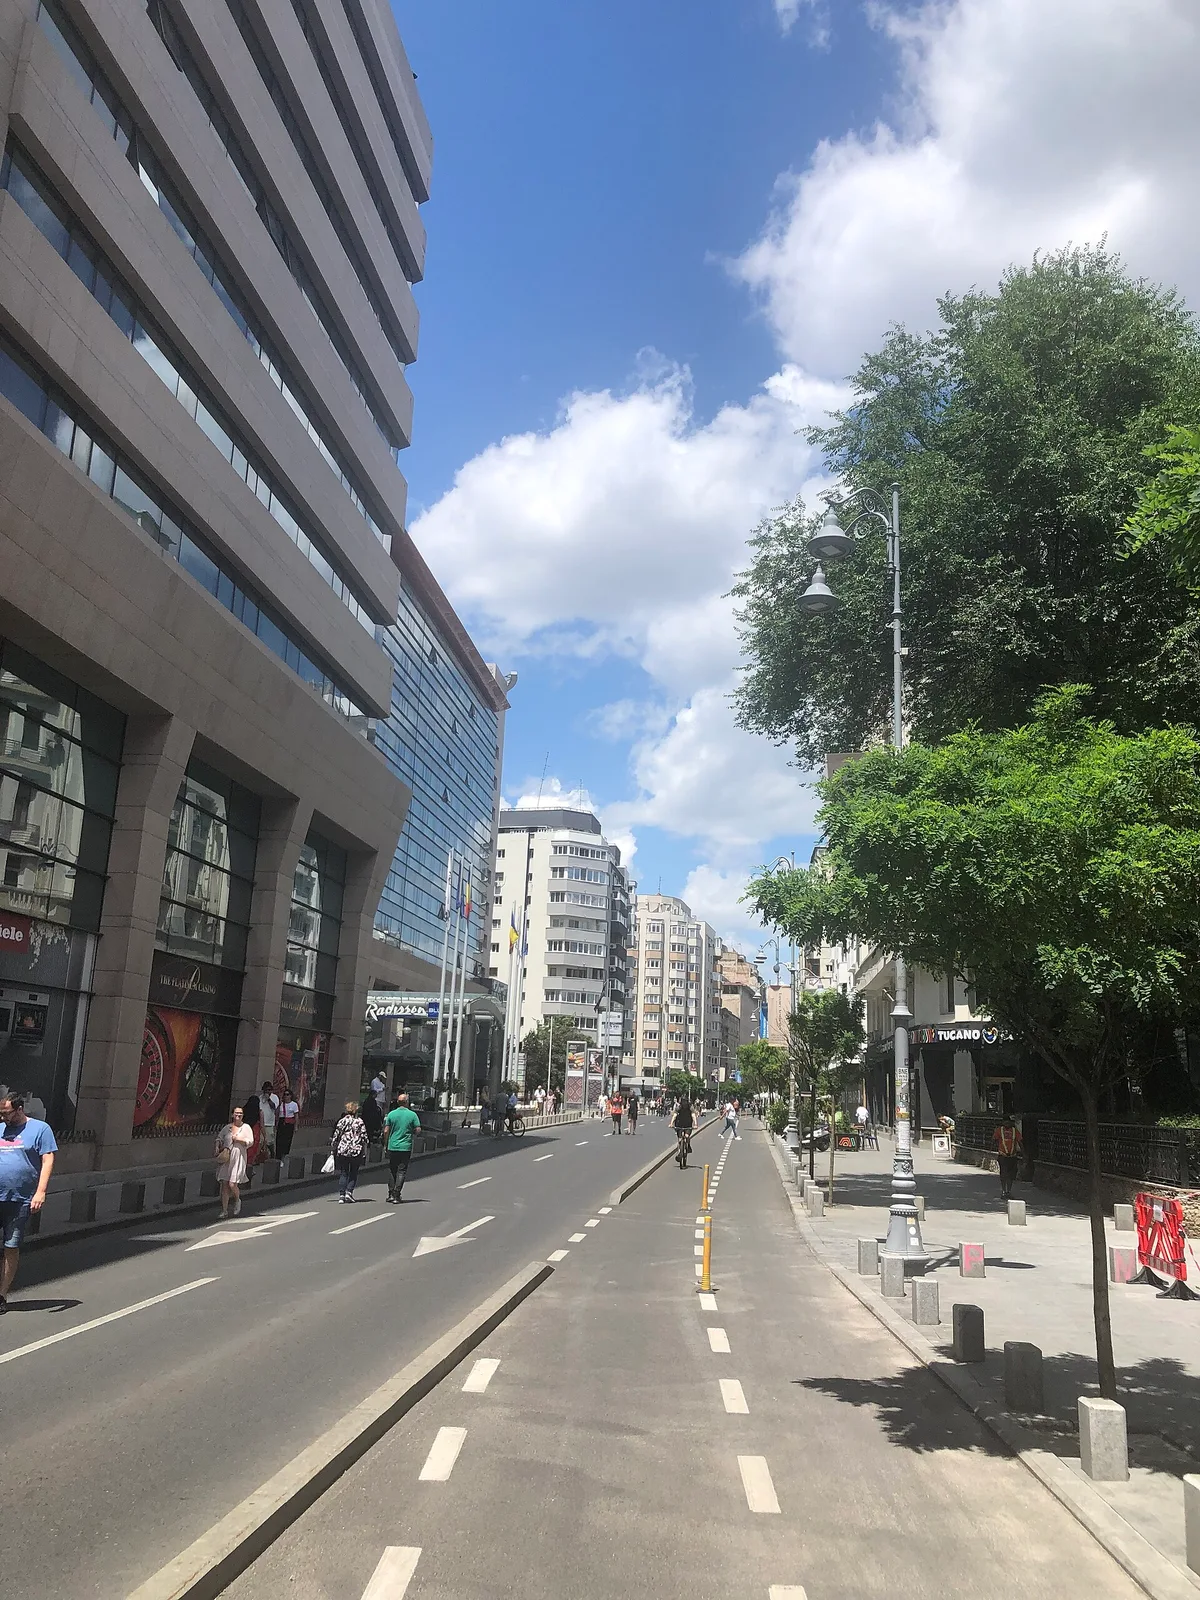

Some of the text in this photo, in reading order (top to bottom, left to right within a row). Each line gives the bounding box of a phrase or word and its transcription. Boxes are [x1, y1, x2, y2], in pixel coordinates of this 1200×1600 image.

[365, 1002, 427, 1021] Radisson
[937, 1029, 981, 1041] TUCANO
[963, 1244, 984, 1273] P
